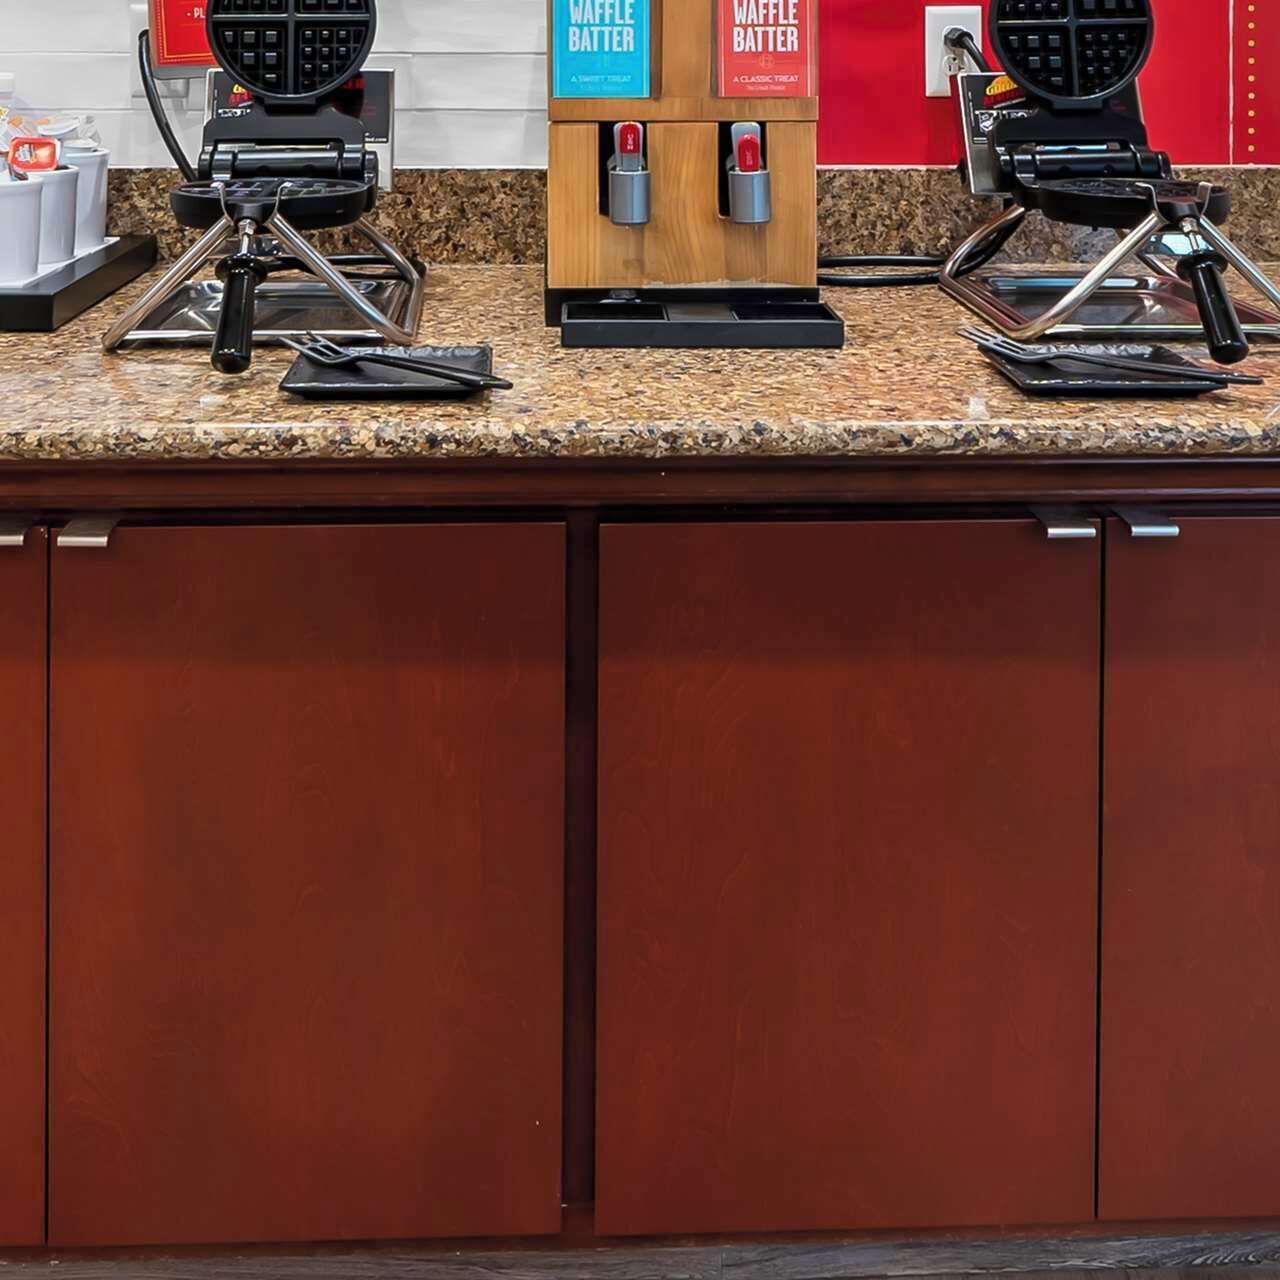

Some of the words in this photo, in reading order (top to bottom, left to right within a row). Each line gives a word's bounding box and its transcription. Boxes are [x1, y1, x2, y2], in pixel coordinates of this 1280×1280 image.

[569, 0, 635, 24] WAFFLE
[733, 0, 799, 24] WAFFLE
[569, 26, 635, 52] BATTER
[733, 26, 799, 52] BATTER
